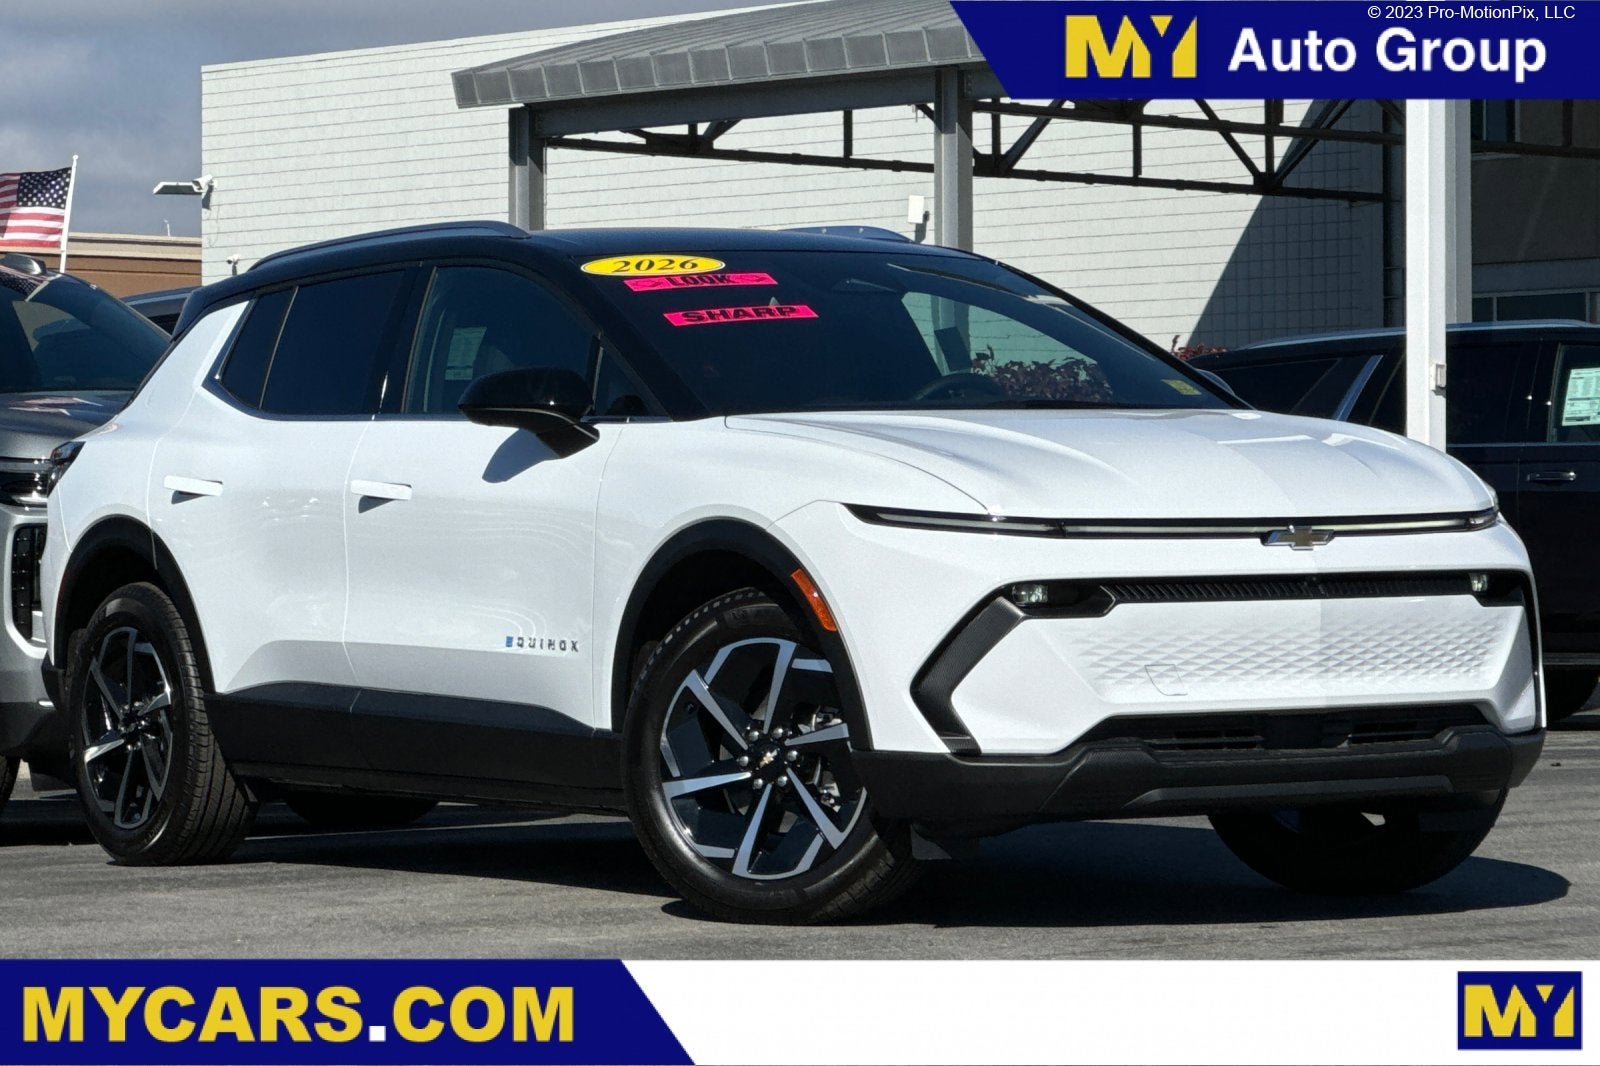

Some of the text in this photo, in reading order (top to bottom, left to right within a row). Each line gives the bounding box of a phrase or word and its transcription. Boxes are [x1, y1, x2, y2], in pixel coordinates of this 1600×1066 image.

[612, 258, 699, 273] 2026
[664, 273, 735, 287] LOOK
[681, 305, 798, 323] SHARP
[505, 635, 579, 653] EQUINOX
